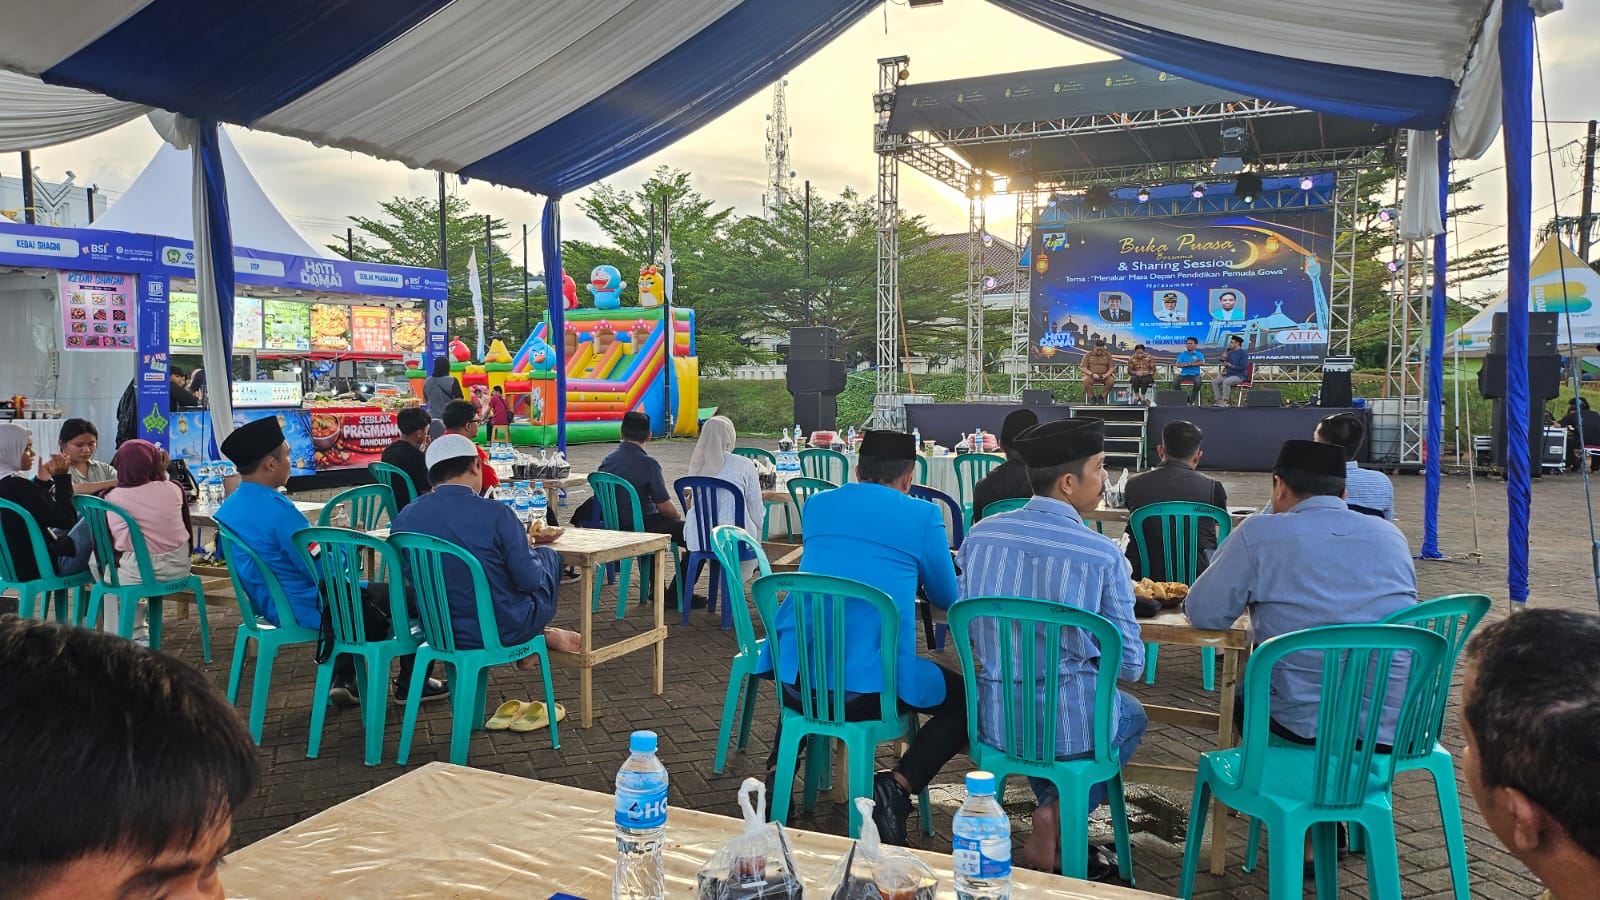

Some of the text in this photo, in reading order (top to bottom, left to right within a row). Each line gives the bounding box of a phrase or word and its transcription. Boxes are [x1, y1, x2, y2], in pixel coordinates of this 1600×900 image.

[16, 239, 35, 249] KEDAI
[1118, 233, 1233, 254] Buka Puasa
[91, 244, 107, 254] BSI
[1118, 260, 1233, 271] & Sharing Session
[1045, 332, 1071, 340] HATI
[358, 414, 392, 424] SEBLAK
[343, 424, 401, 438] PRASMANA
[360, 438, 392, 447] BANDUNG
